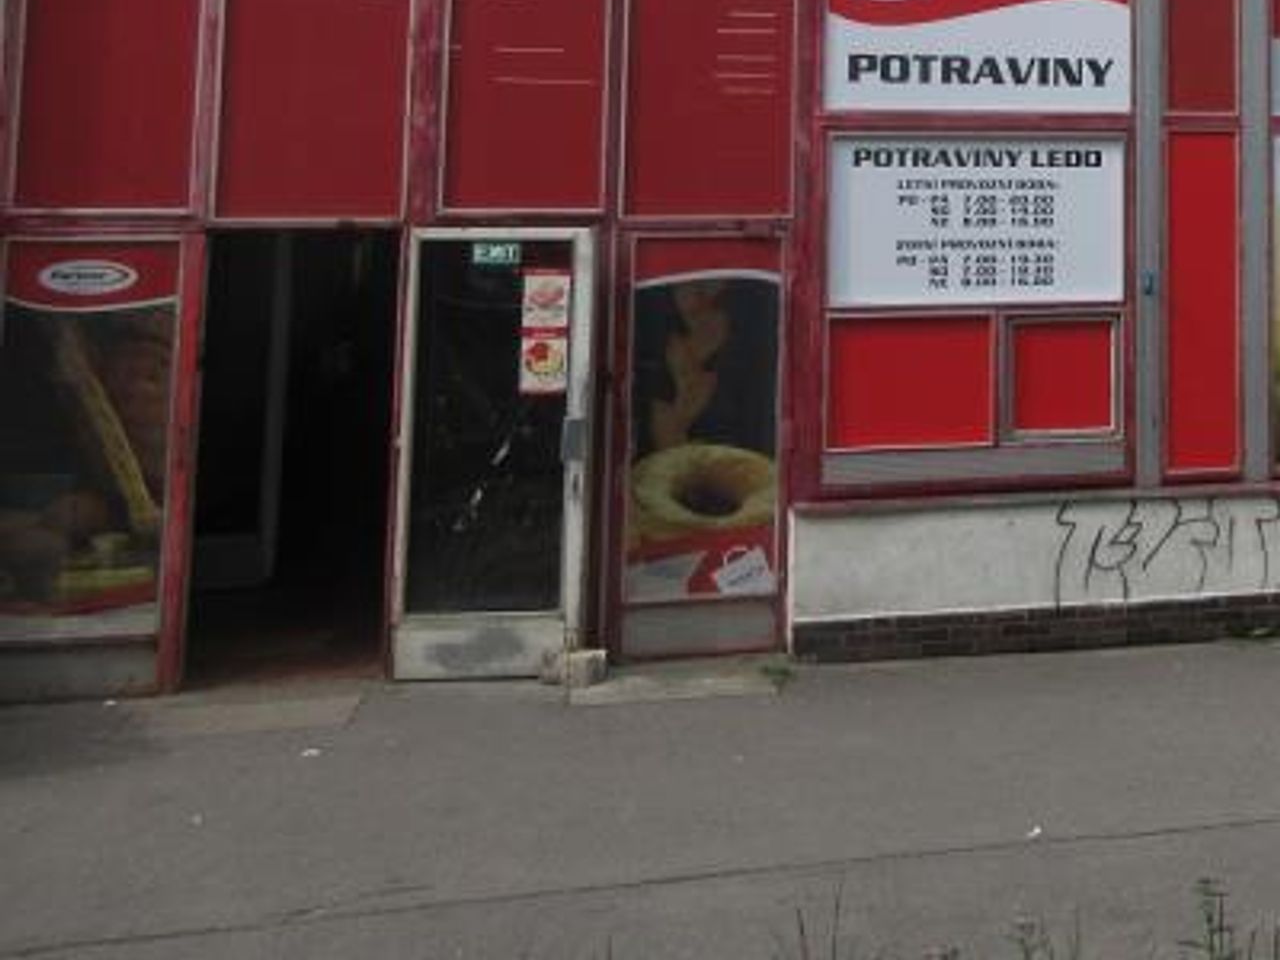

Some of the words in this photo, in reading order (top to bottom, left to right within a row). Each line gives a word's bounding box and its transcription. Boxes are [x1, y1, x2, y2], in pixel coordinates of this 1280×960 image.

[848, 54, 1114, 87] POTRAVINY
[853, 147, 1022, 168] POTRAVINY
[1030, 149, 1103, 168] LEDO
